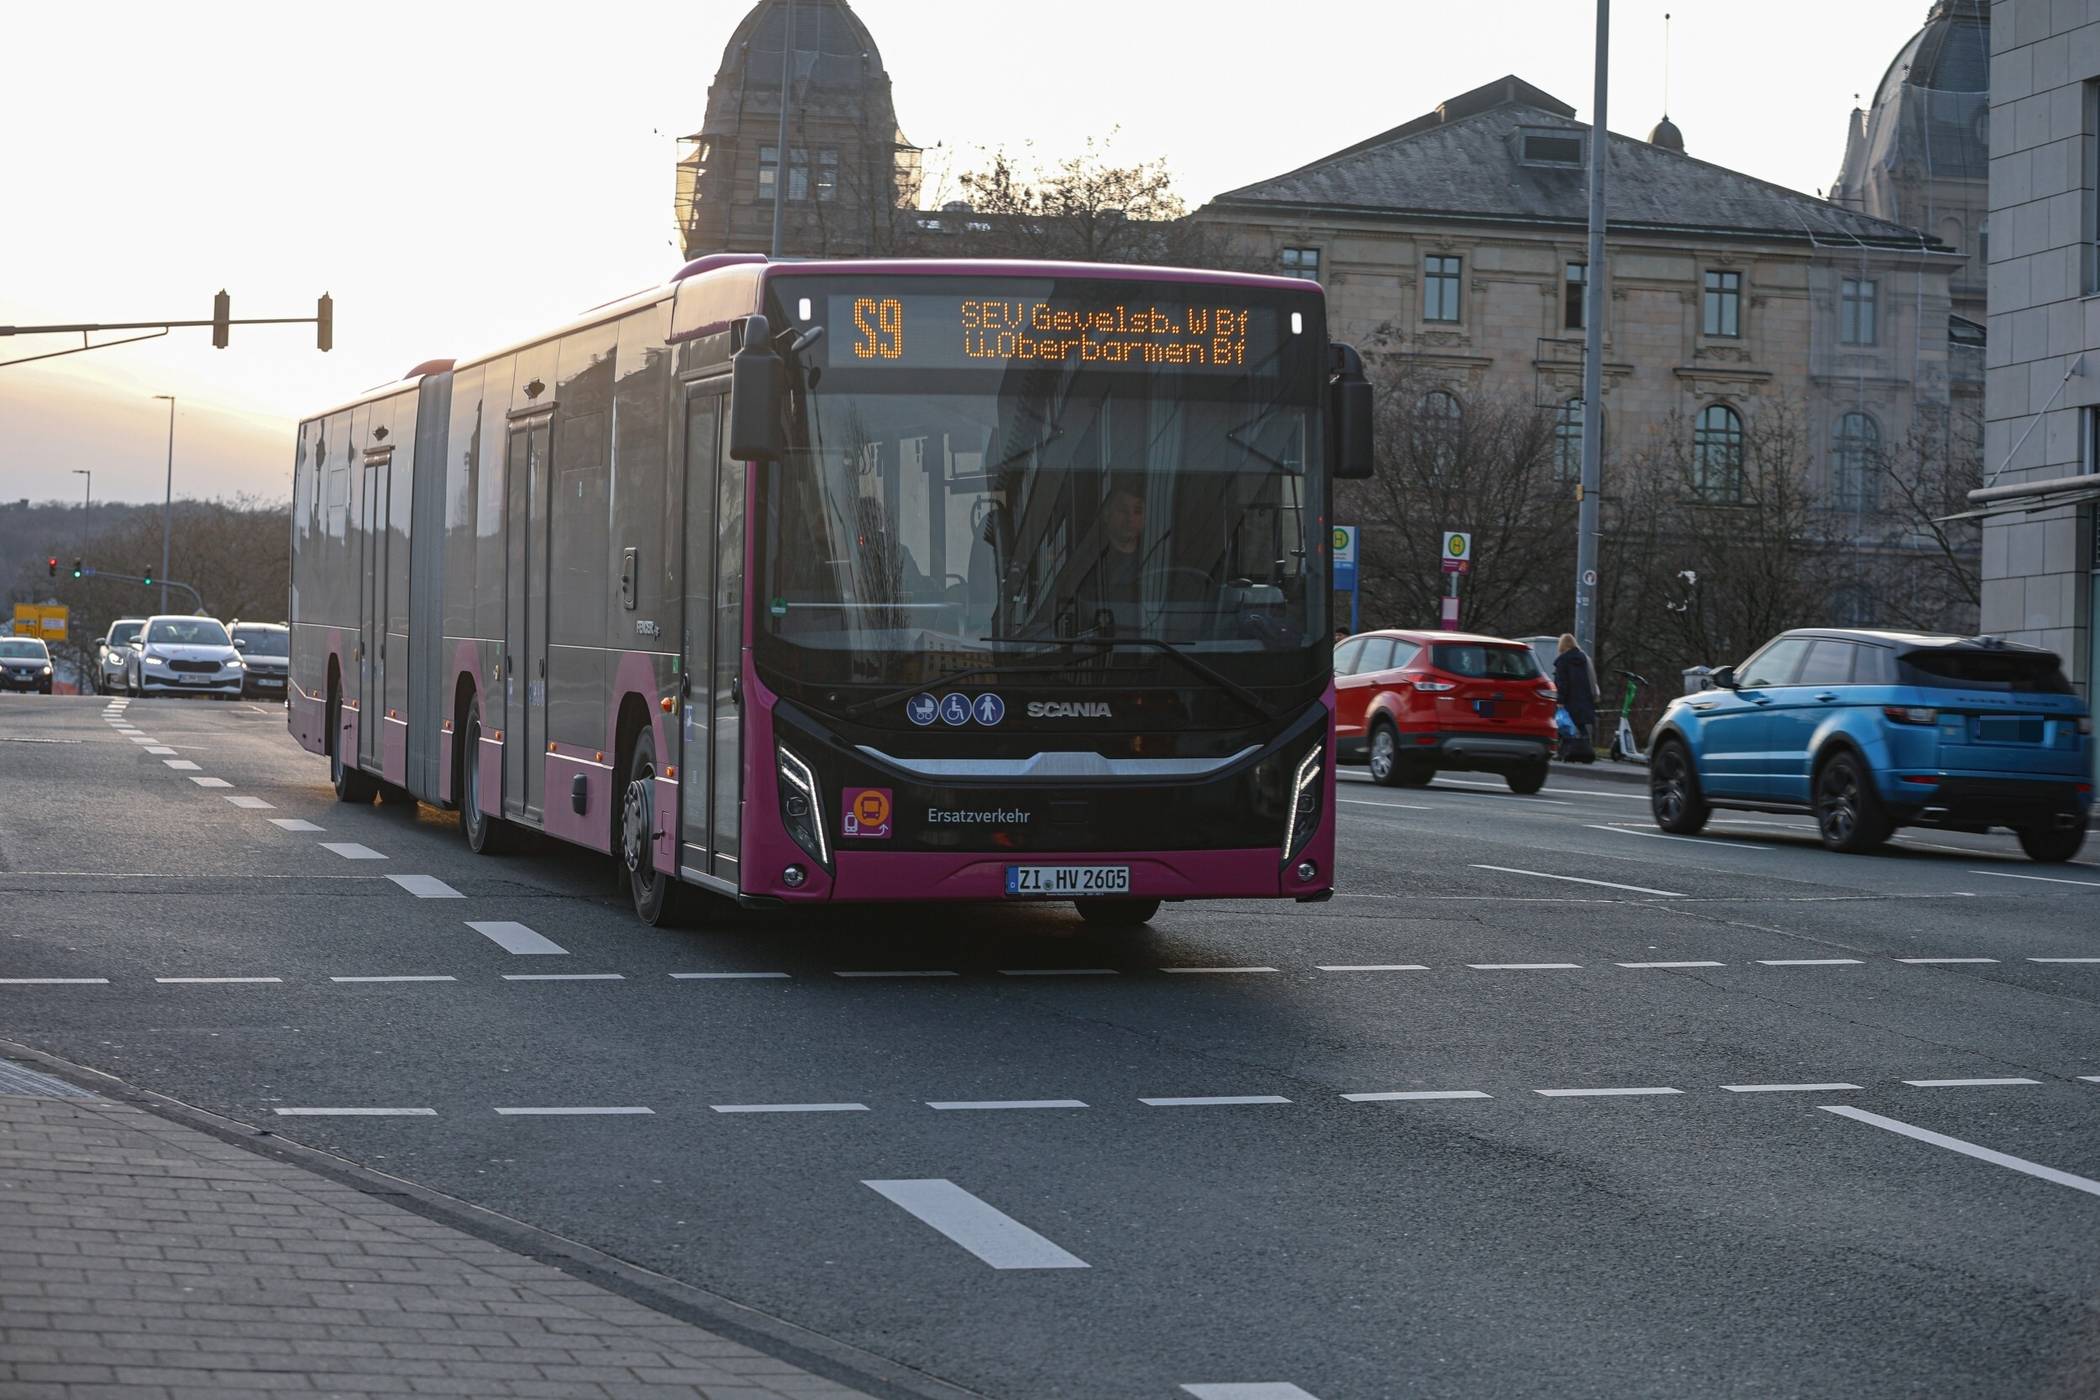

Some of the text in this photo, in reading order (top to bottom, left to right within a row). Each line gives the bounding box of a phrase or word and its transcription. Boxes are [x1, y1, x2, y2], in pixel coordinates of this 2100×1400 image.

[855, 298, 902, 358] S9
[962, 301, 1248, 336] SEV Gevelsb. W Bf
[1213, 337, 1245, 365] Bf
[1027, 702, 1112, 717] SCANIA
[928, 808, 1030, 823] Ersatzverkehr
[1020, 869, 1041, 889] ZI
[1056, 869, 1079, 889] HV
[1083, 869, 1127, 889] 2605
